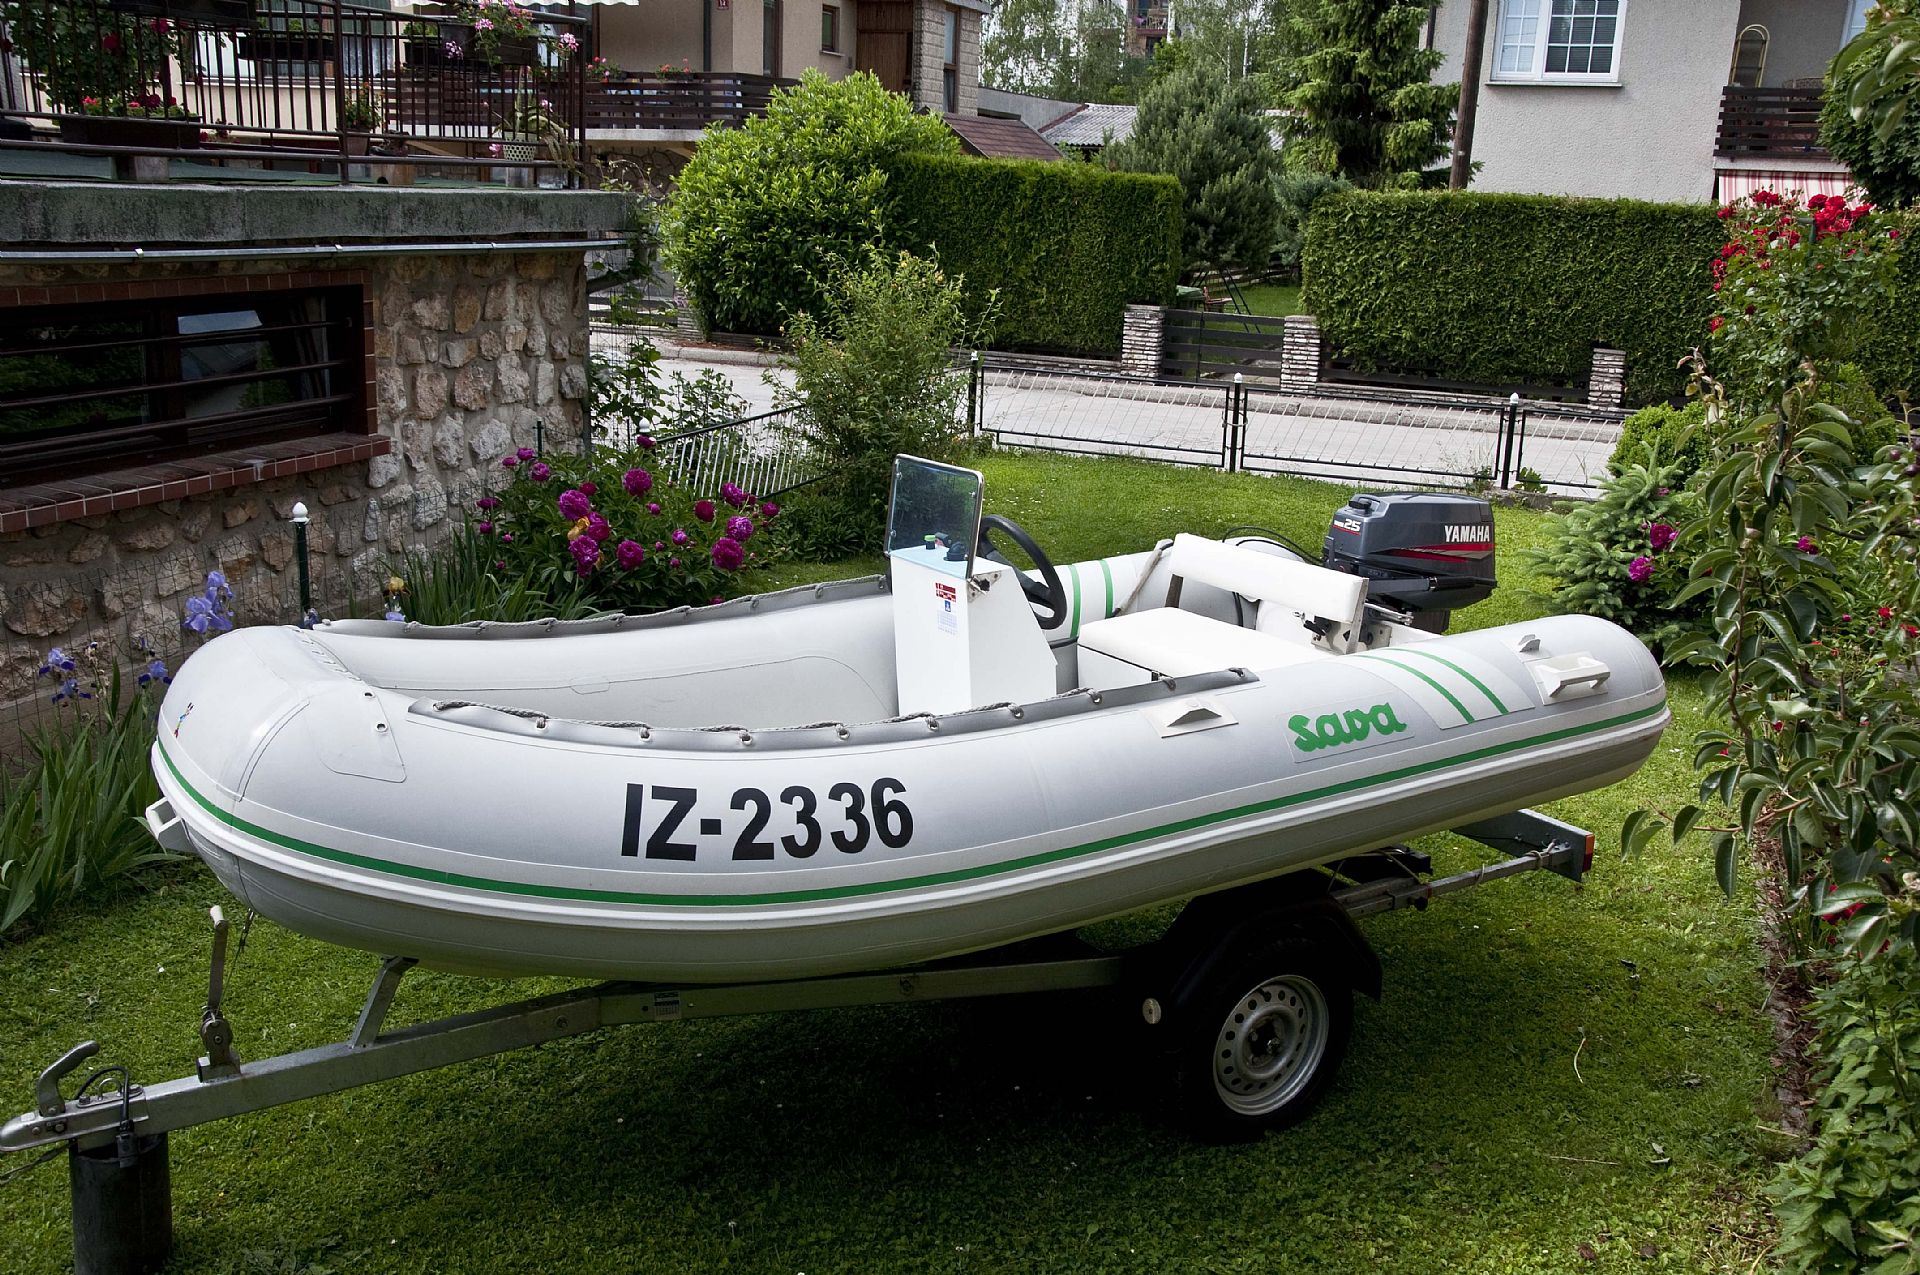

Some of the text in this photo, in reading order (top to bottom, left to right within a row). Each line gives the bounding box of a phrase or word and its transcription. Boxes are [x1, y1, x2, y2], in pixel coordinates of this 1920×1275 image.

[1344, 518, 1361, 531] 25
[1444, 525, 1490, 542] YAMAHA
[621, 777, 914, 861] IZ-2336
